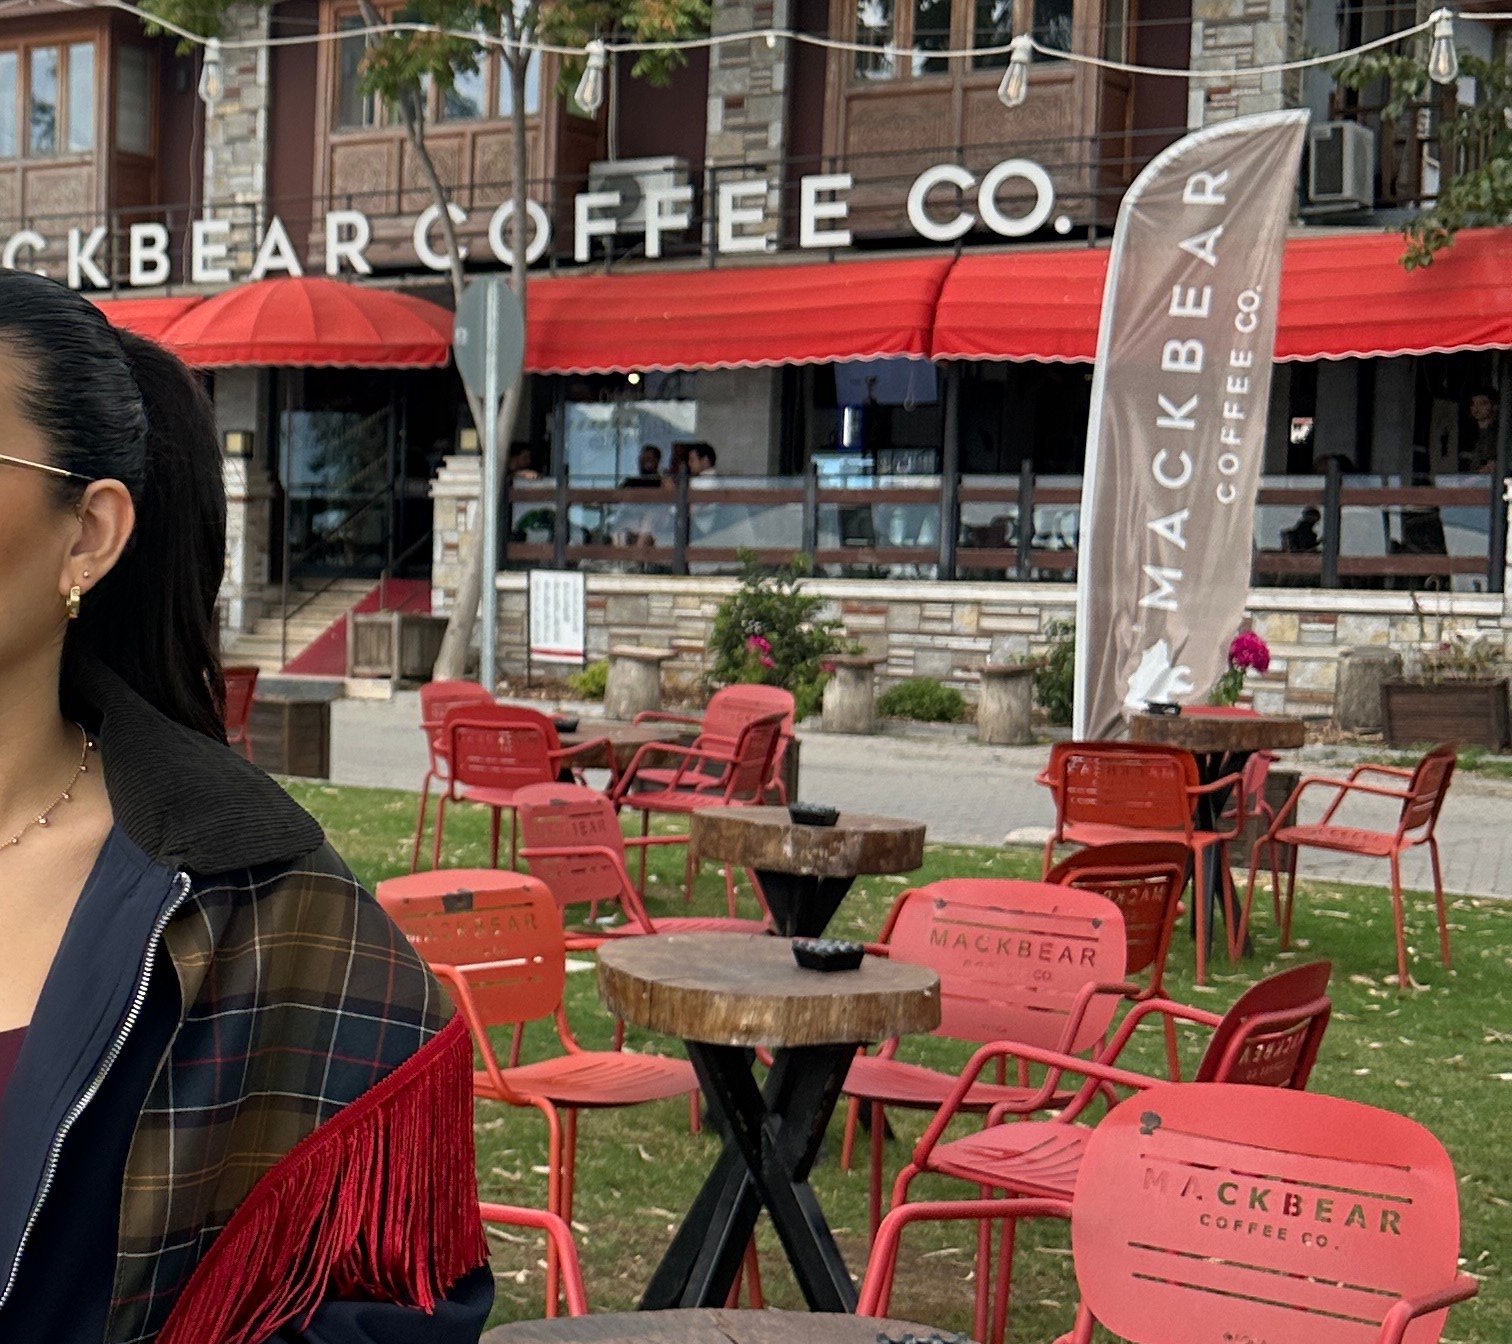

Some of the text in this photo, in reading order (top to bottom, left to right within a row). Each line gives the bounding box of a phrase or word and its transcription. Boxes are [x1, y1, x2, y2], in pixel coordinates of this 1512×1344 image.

[413, 173, 853, 271] COFFEE
[907, 158, 1073, 241] CO.
[1138, 168, 1229, 612] MACKBEAR
[1216, 348, 1253, 504] COFFEE
[930, 927, 1097, 968] MACKBEAR
[1142, 1167, 1402, 1236] MACKBEAR
[1199, 1213, 1287, 1240] COFFEE
